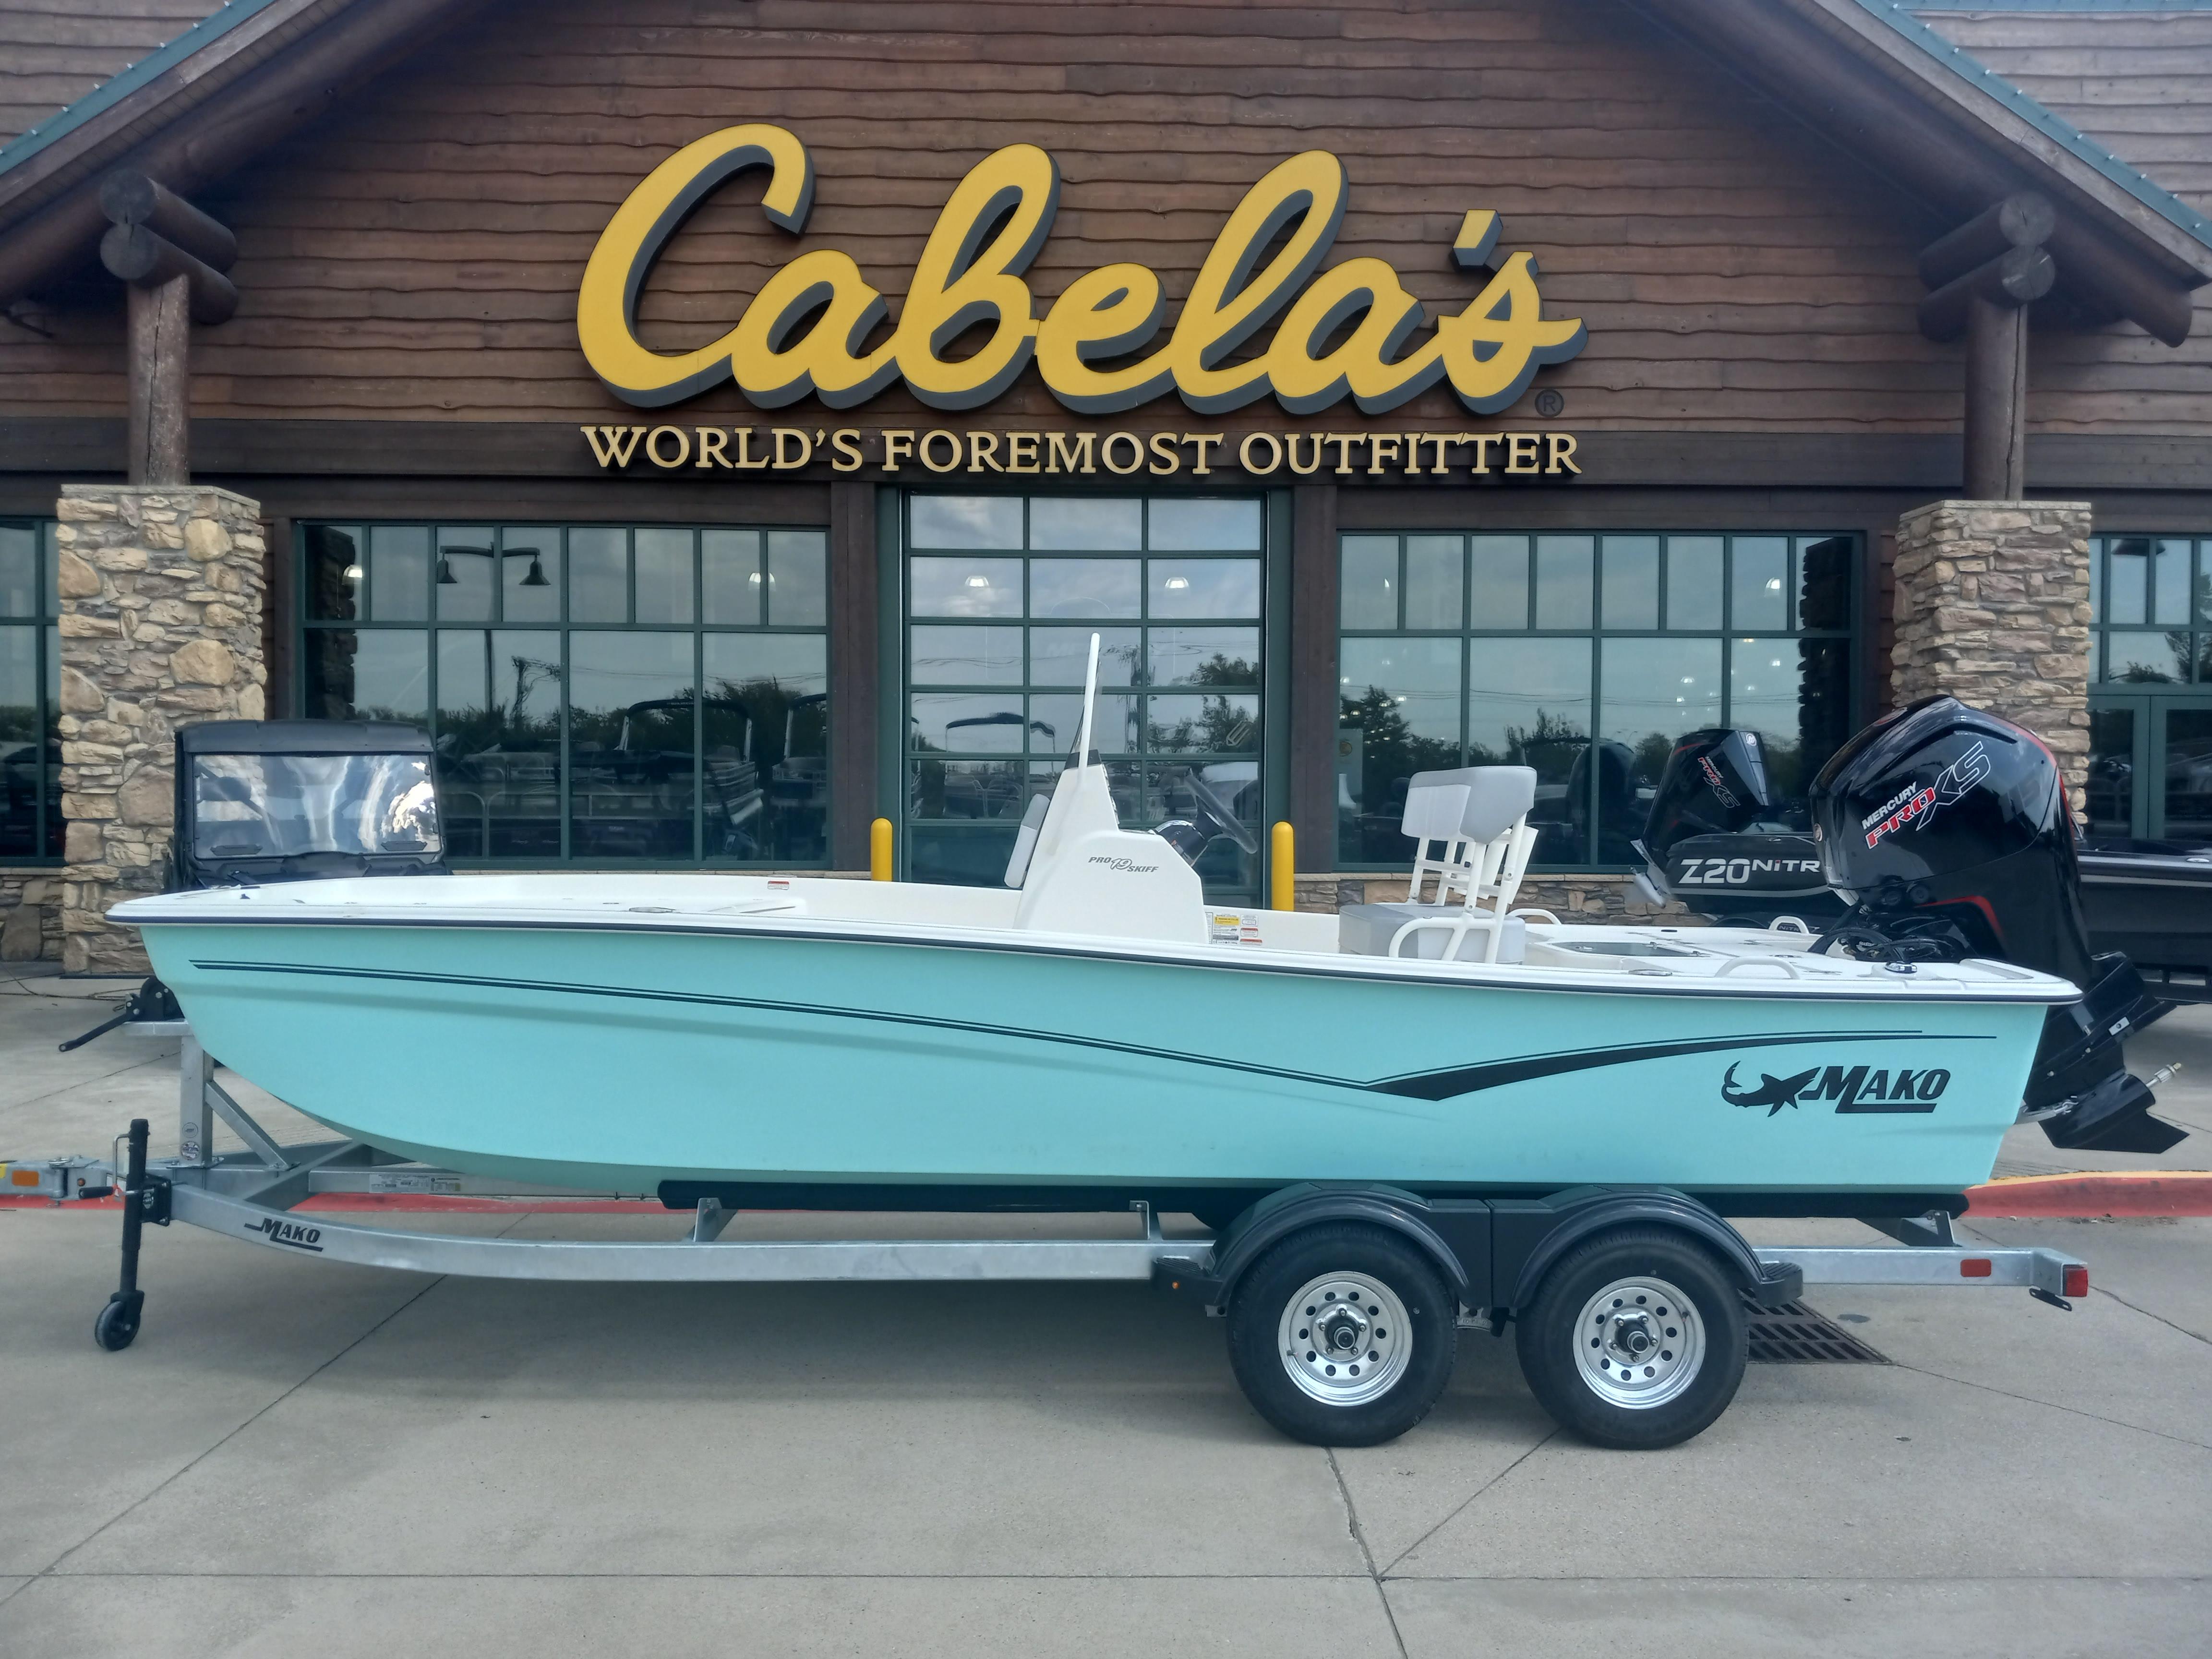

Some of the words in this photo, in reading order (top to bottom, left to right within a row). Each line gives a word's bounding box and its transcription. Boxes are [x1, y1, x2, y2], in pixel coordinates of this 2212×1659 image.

[577, 123, 1586, 415] Cabela's
[579, 426, 864, 472] WORLD'S
[881, 429, 1224, 475] FOREMOST
[1238, 432, 1583, 475] OUTFITTER
[1697, 757, 1721, 786] PRO
[1705, 756, 1724, 778] MERCURY
[1703, 777, 1741, 808] XS
[1862, 781, 1917, 830] MERCURY
[1865, 787, 1936, 849] PRO
[1915, 740, 1991, 831] XS
[1110, 858, 1132, 870] 19
[1678, 858, 1750, 884] Z20
[1752, 859, 1821, 872] NiTR
[1798, 1066, 1951, 1114] MAKO
[244, 1218, 324, 1252] MAKO
